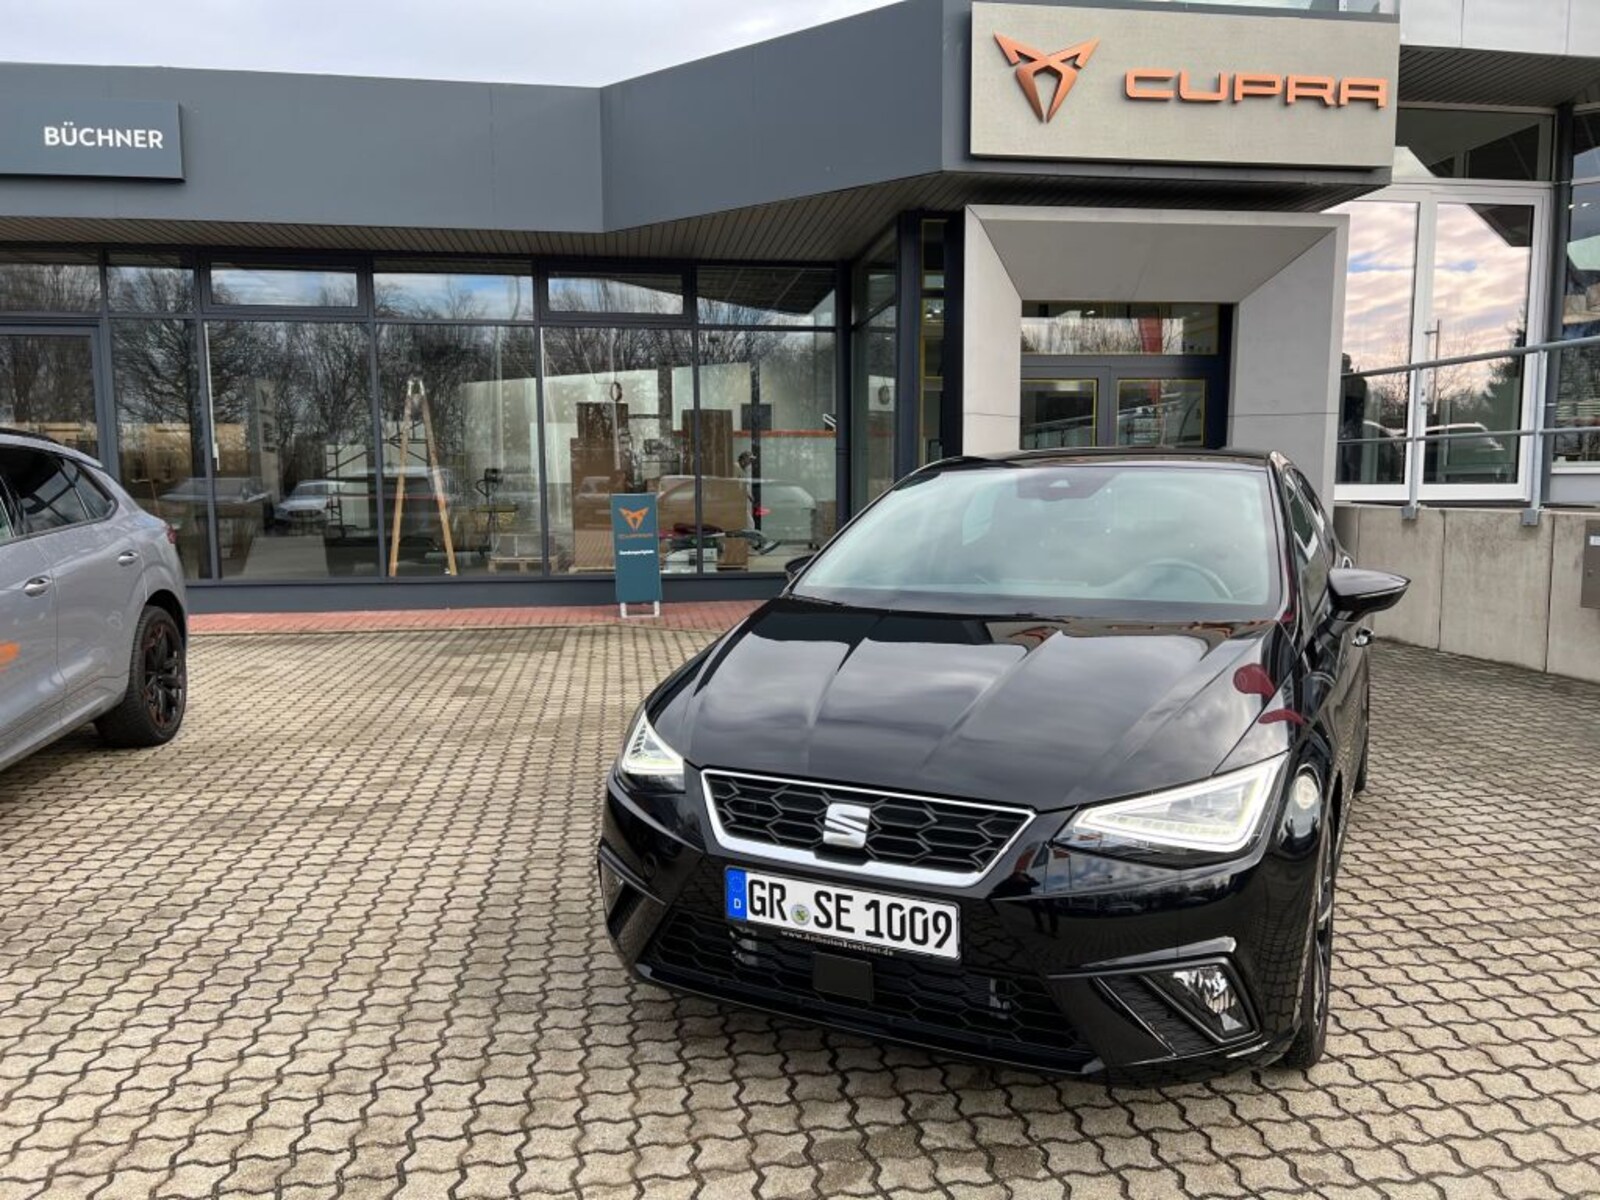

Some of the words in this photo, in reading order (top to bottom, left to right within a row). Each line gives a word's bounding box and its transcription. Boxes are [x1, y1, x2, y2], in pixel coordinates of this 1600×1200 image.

[1125, 68, 1388, 108] CUPRA
[44, 121, 163, 149] BÜCHNER
[733, 897, 742, 909] D
[748, 879, 787, 921] GR
[814, 890, 855, 933] SE
[865, 899, 952, 949] 1009
